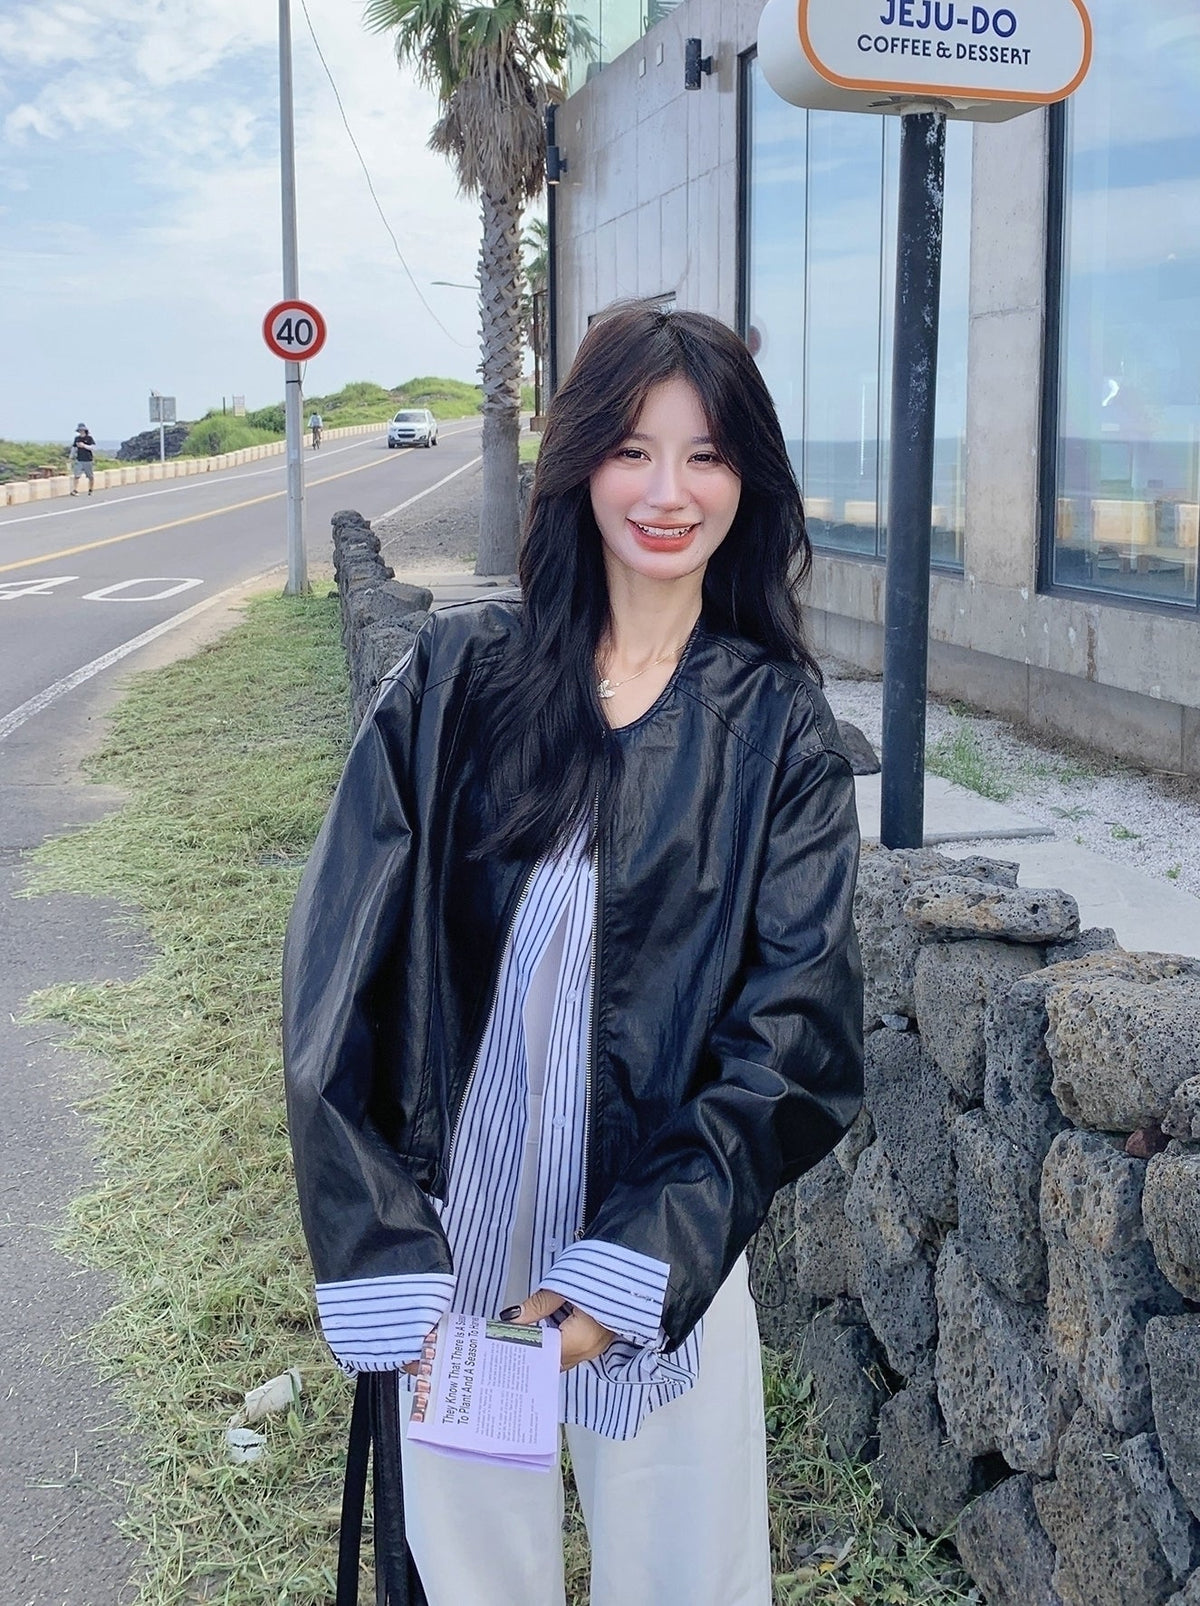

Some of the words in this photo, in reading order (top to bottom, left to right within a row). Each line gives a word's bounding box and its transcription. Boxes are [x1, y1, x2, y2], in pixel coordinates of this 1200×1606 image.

[880, 0, 1017, 38] JEJU-DO
[857, 34, 932, 57] COFFEE
[936, 41, 952, 58] &
[956, 42, 1031, 65] DESSERT
[276, 318, 313, 346] 40
[451, 1339, 464, 1360] There
[464, 1339, 478, 1366] Season
[448, 1362, 461, 1379] That
[445, 1381, 458, 1404] Know
[461, 1375, 474, 1393] And
[442, 1405, 458, 1424] They
[459, 1394, 472, 1414] Plant
[457, 1415, 469, 1424] To
